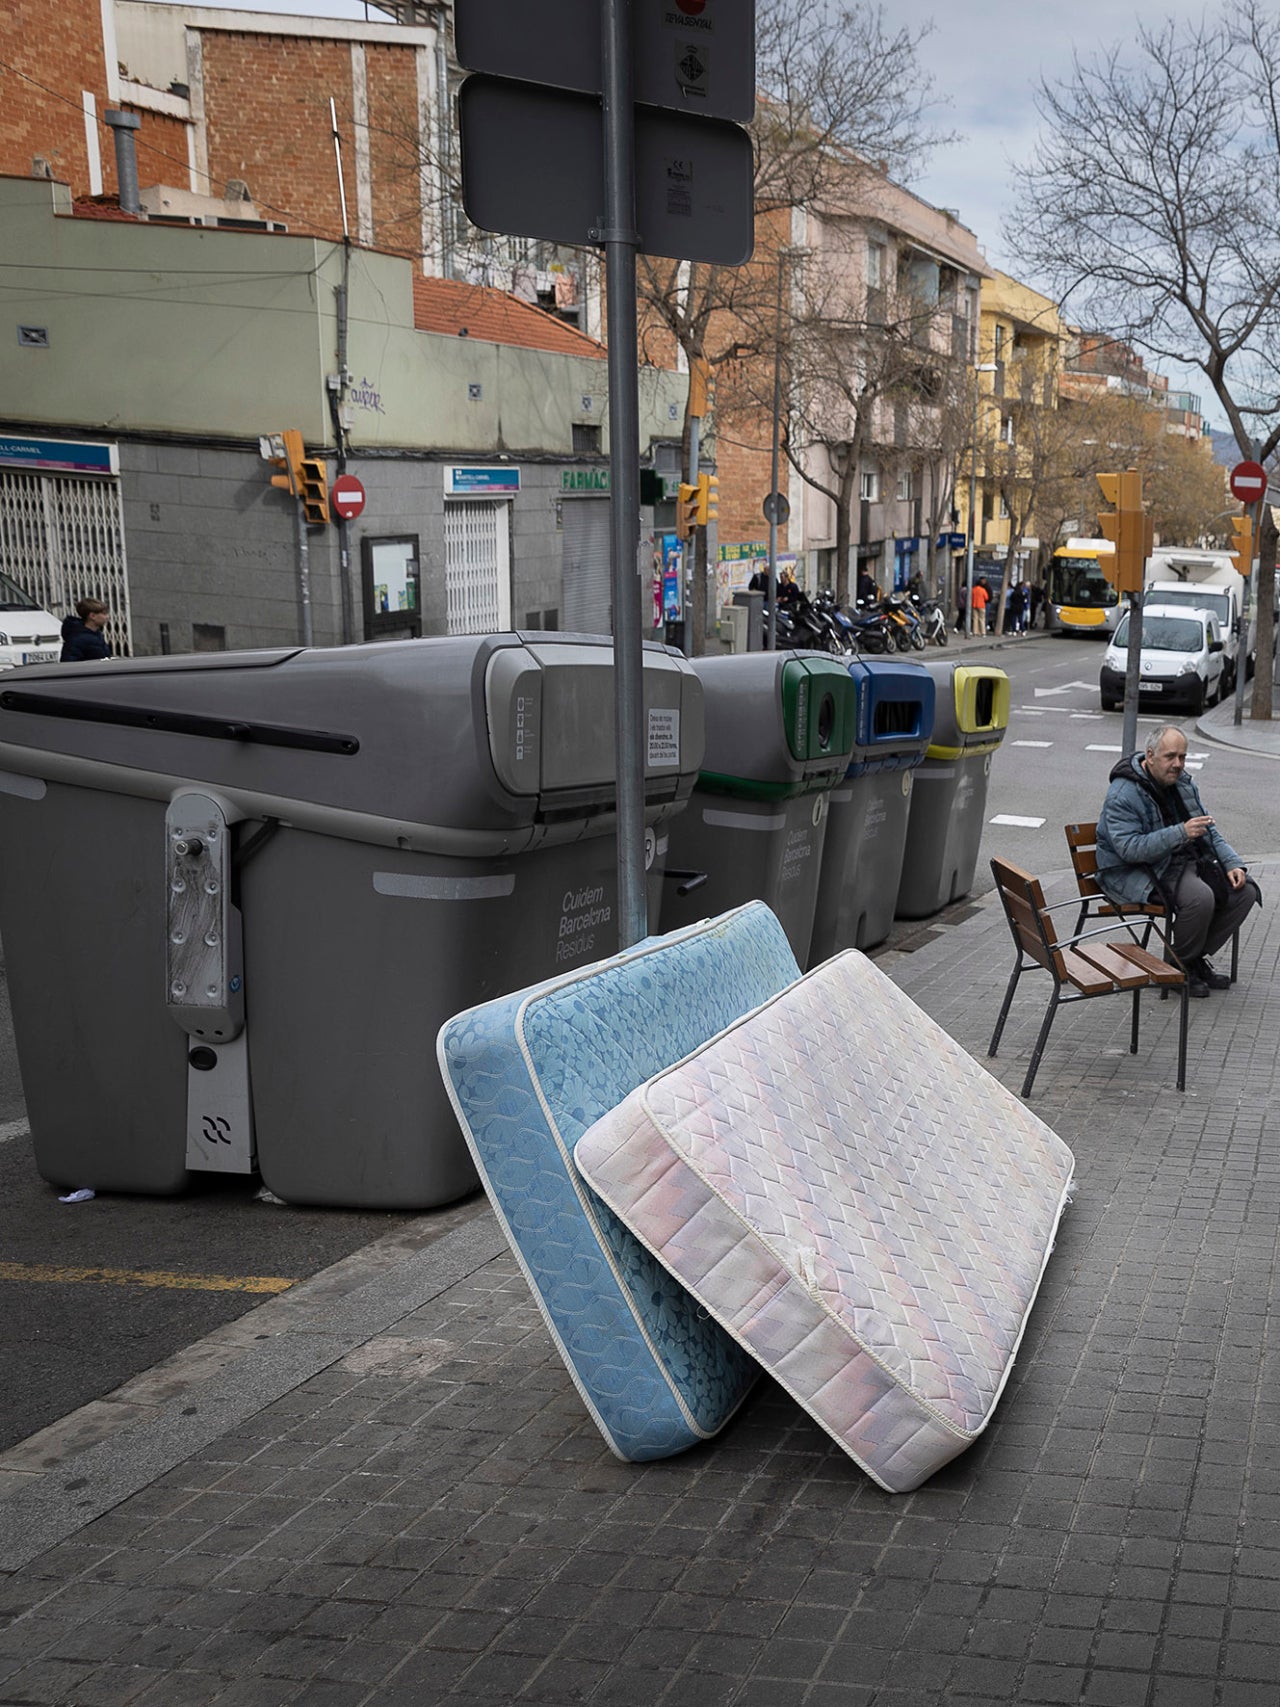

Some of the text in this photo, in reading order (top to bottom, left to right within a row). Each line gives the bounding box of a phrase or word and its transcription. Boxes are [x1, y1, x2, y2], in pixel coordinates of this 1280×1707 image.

[562, 886, 604, 912] Cuidem
[559, 906, 611, 937] Barcelona
[556, 933, 595, 963] Residus
